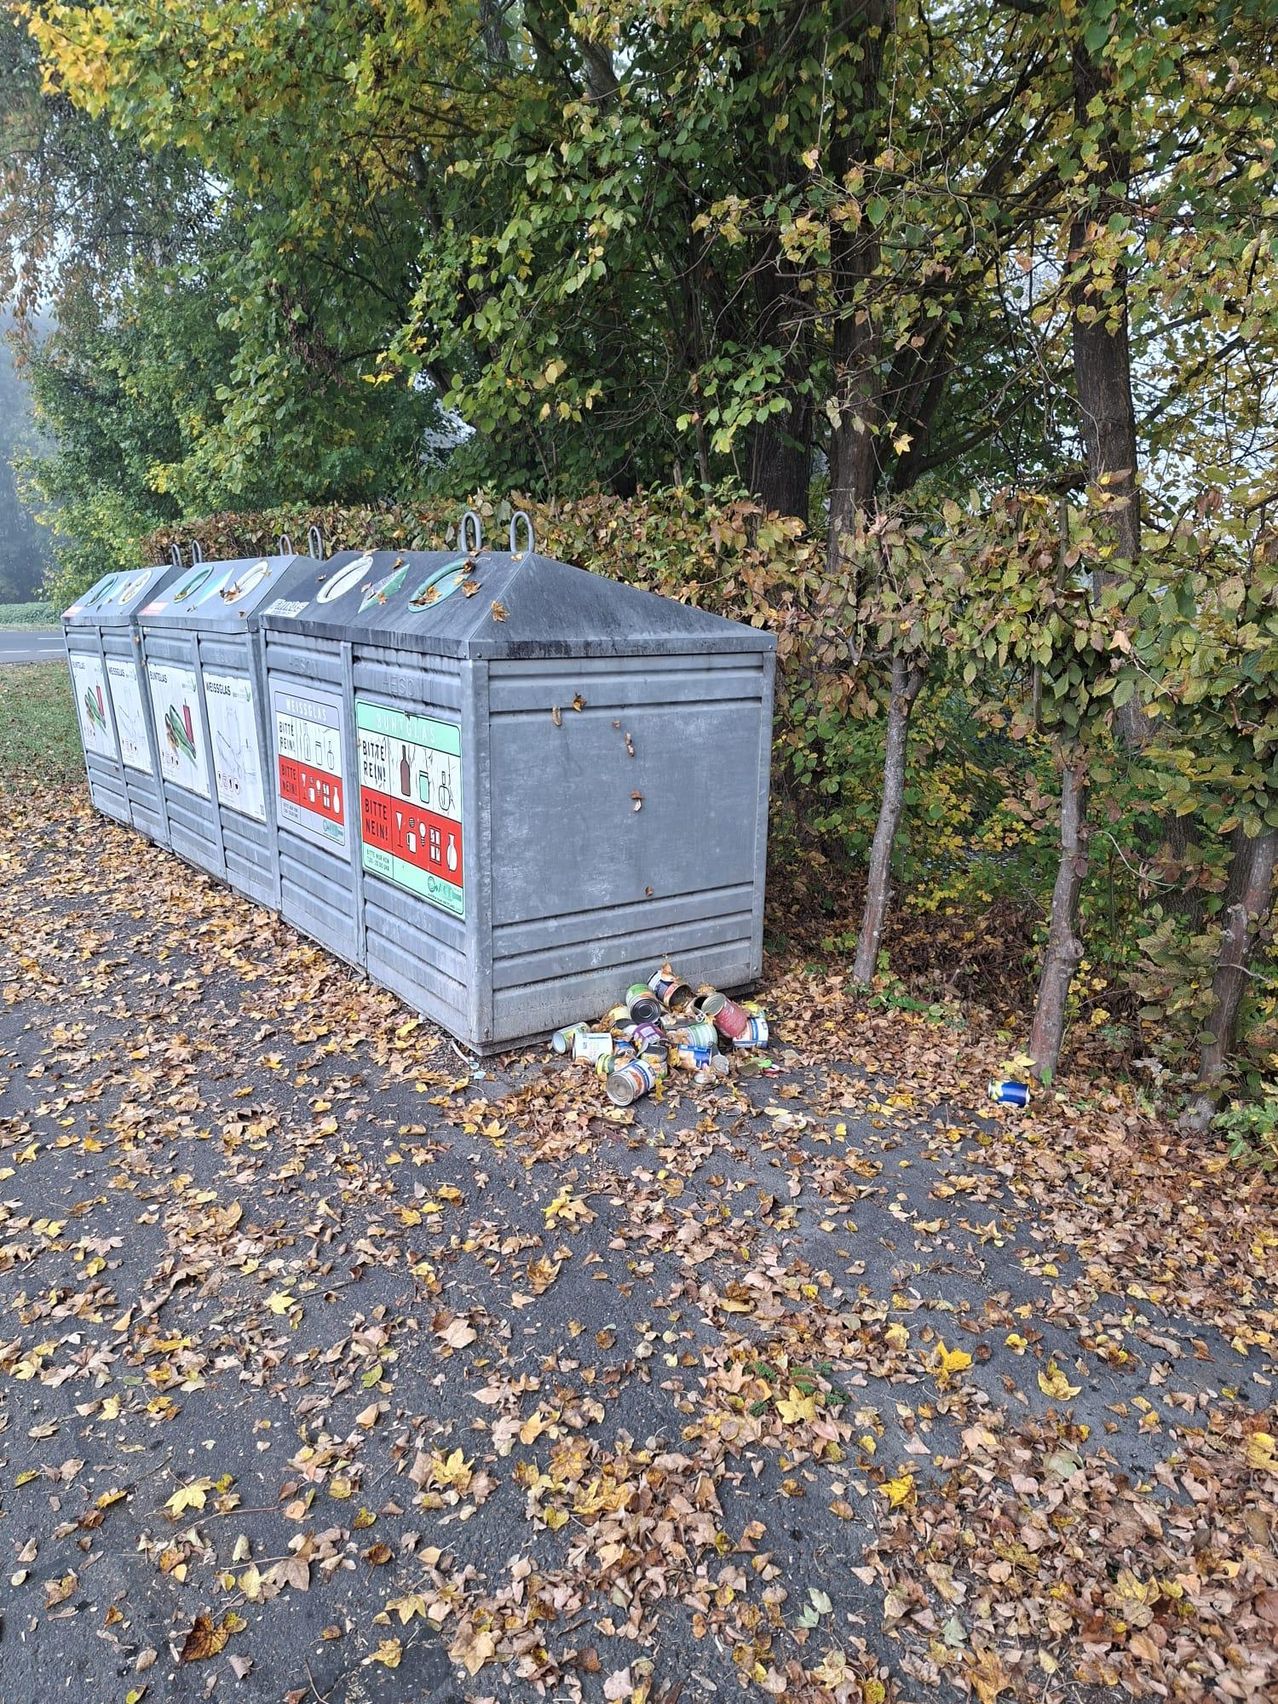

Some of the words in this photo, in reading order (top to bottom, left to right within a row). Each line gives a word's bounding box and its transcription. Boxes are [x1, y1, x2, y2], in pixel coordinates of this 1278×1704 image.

[206, 682, 231, 696] WEISSGLAS
[285, 697, 327, 722] WEISSGLAS
[279, 720, 294, 738] BITTE
[376, 714, 434, 742] BUNTGLAS
[279, 737, 296, 755] REIN!
[362, 739, 385, 762] BITTE
[281, 766, 296, 784] BITTE
[364, 761, 387, 784] REIN!
[365, 798, 387, 821] BITTE
[366, 819, 389, 841] NEIN!
